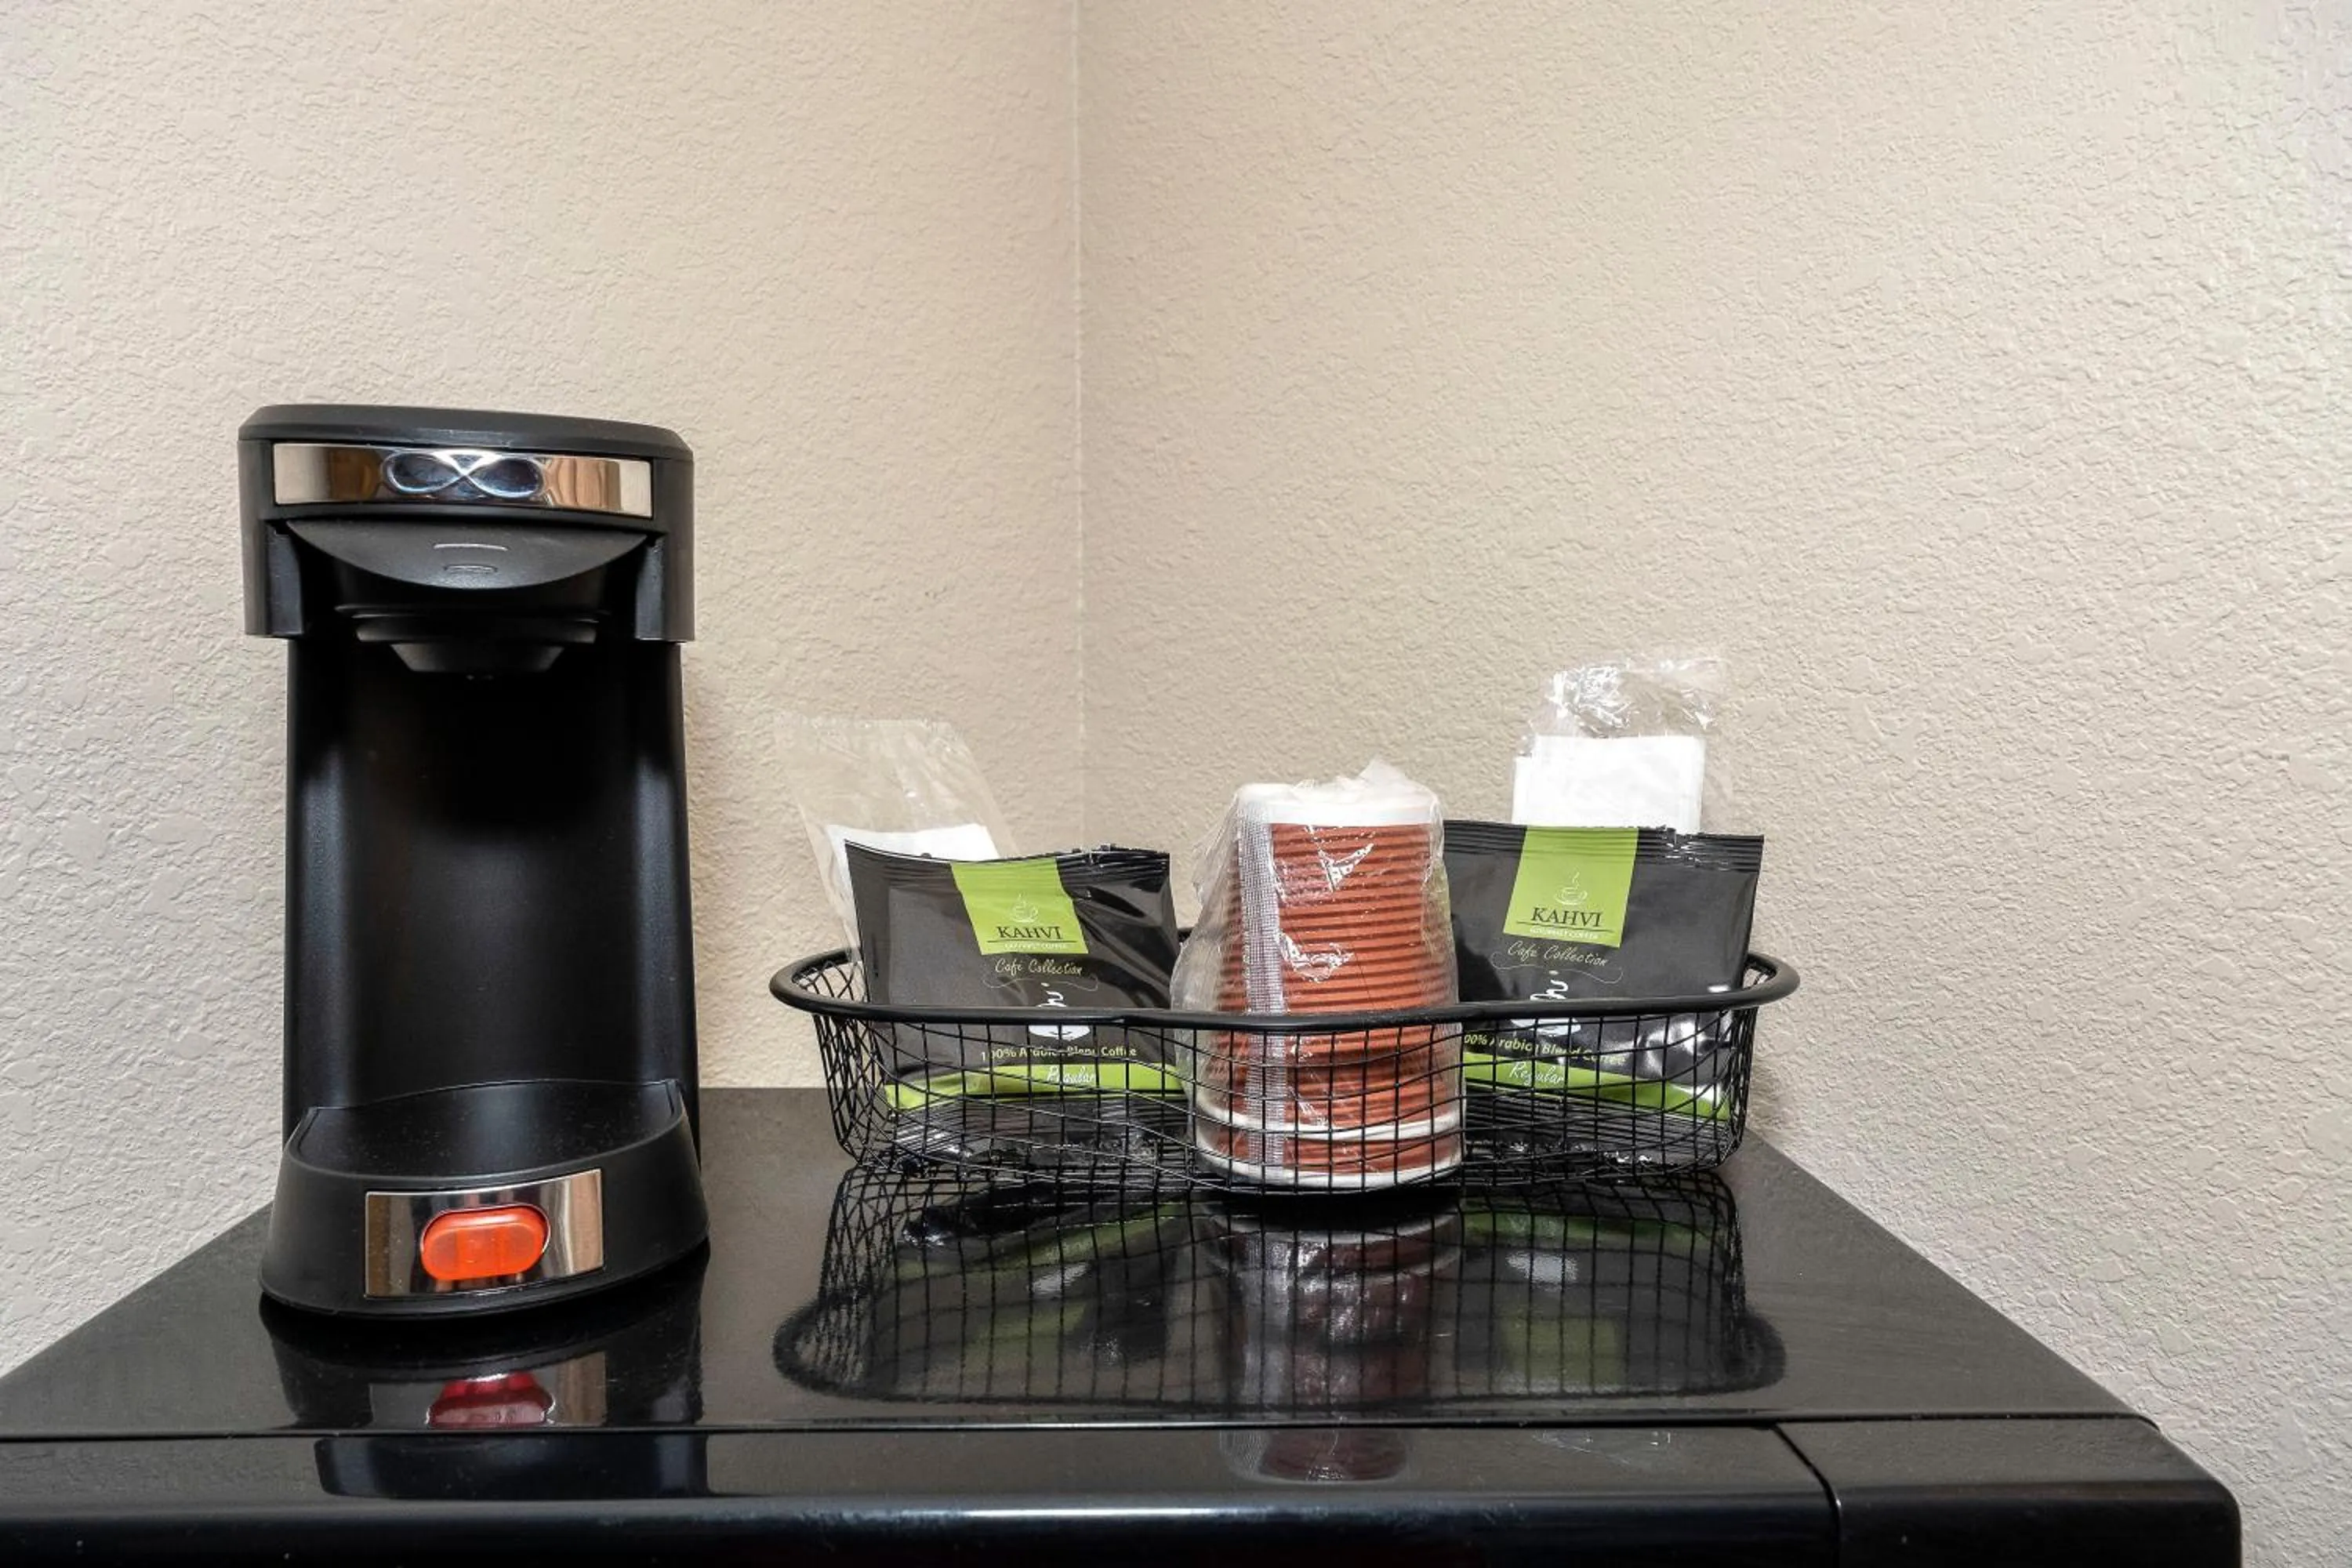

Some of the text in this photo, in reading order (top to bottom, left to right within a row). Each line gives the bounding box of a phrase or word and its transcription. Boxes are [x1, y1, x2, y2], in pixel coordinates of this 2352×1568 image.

[1531, 907, 1603, 927] KAHVI
[996, 926, 1063, 939] KAHVI
[1544, 945, 1610, 967] Collection
[1028, 958, 1083, 976] Collection
[1018, 1047, 1065, 1058] Aabic
[1067, 1046, 1096, 1056] Blen
[1101, 1046, 1137, 1057] Coffe
[1047, 1065, 1096, 1087] Rgular
